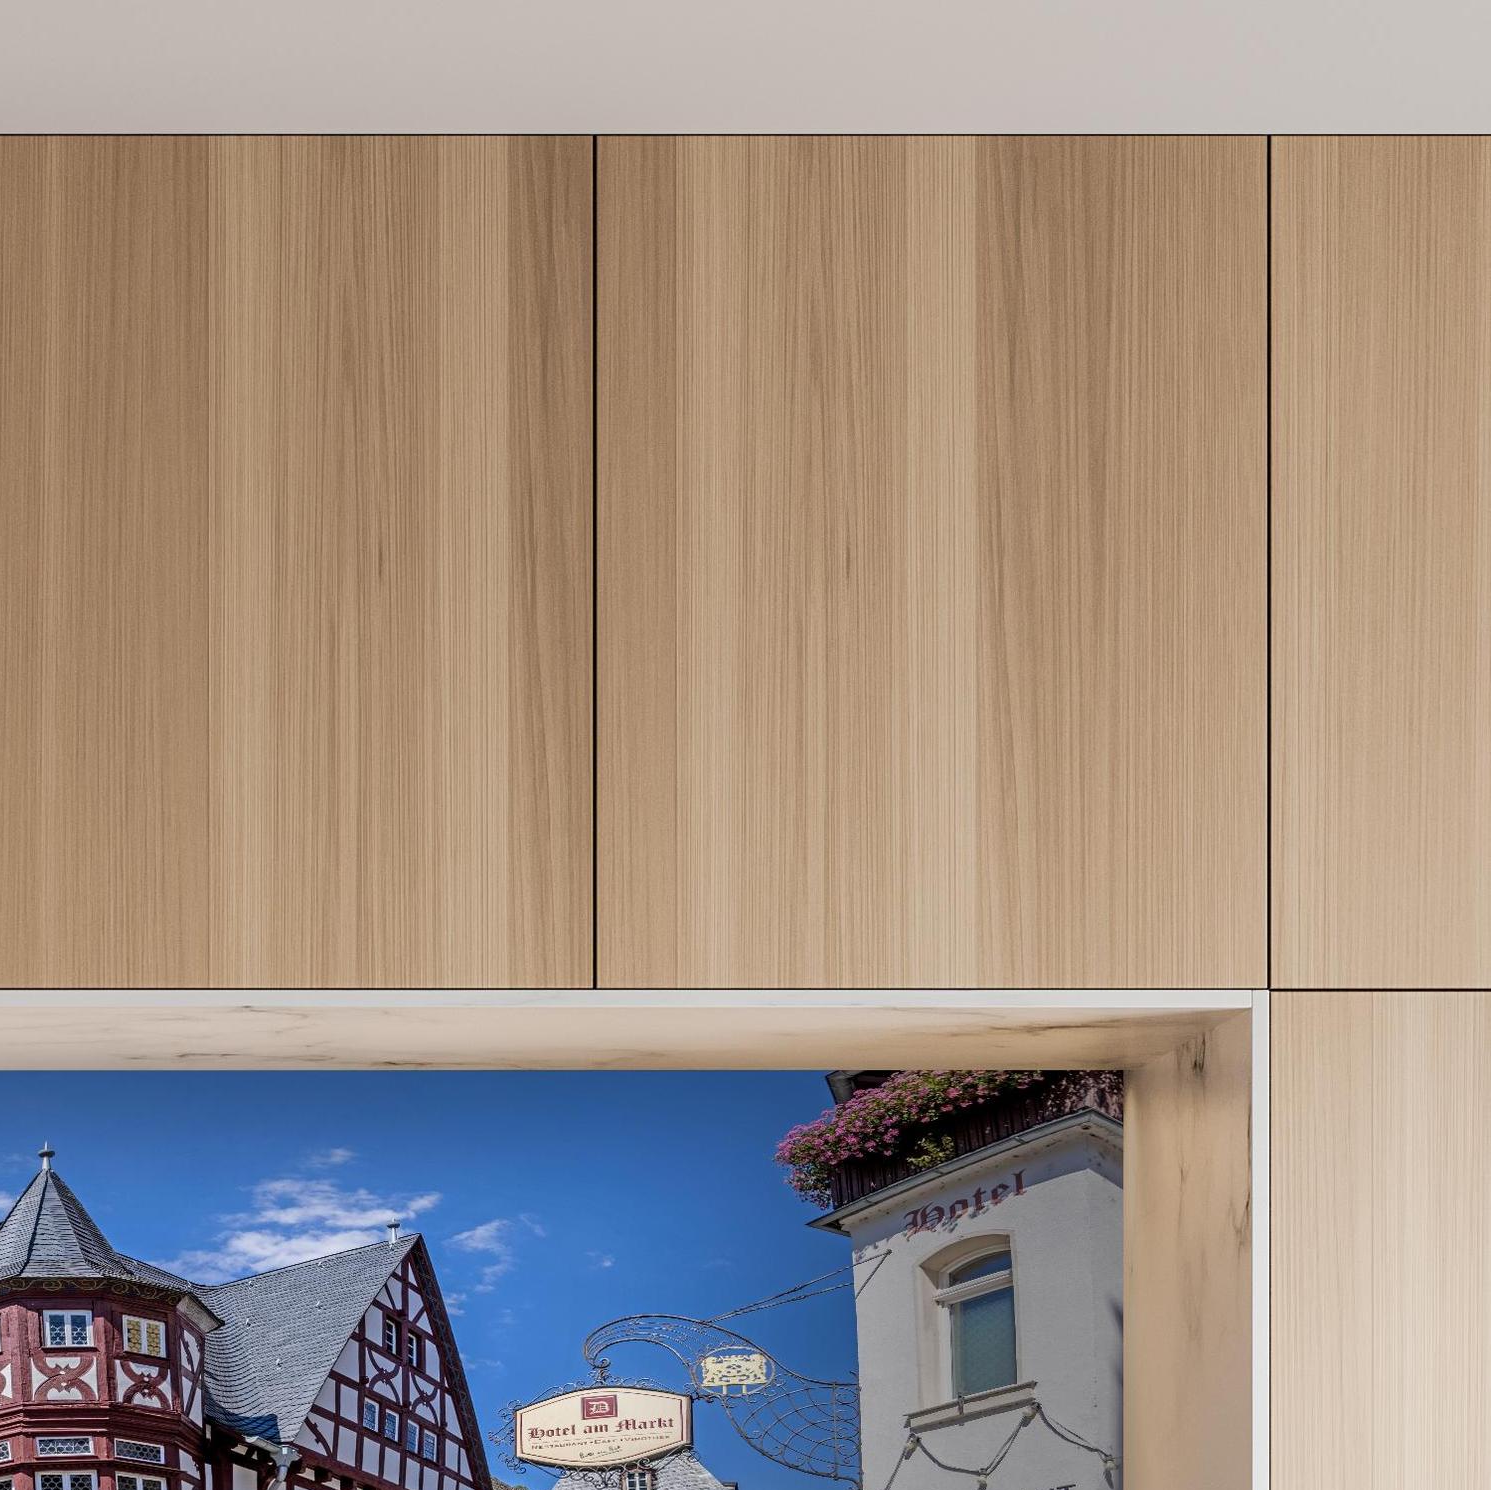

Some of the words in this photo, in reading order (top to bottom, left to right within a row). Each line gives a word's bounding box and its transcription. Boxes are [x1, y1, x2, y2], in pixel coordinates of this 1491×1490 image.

[904, 1169, 1027, 1241] Hotel
[527, 1424, 576, 1441] Hotel
[583, 1423, 609, 1435] am
[614, 1417, 675, 1433] Markt
